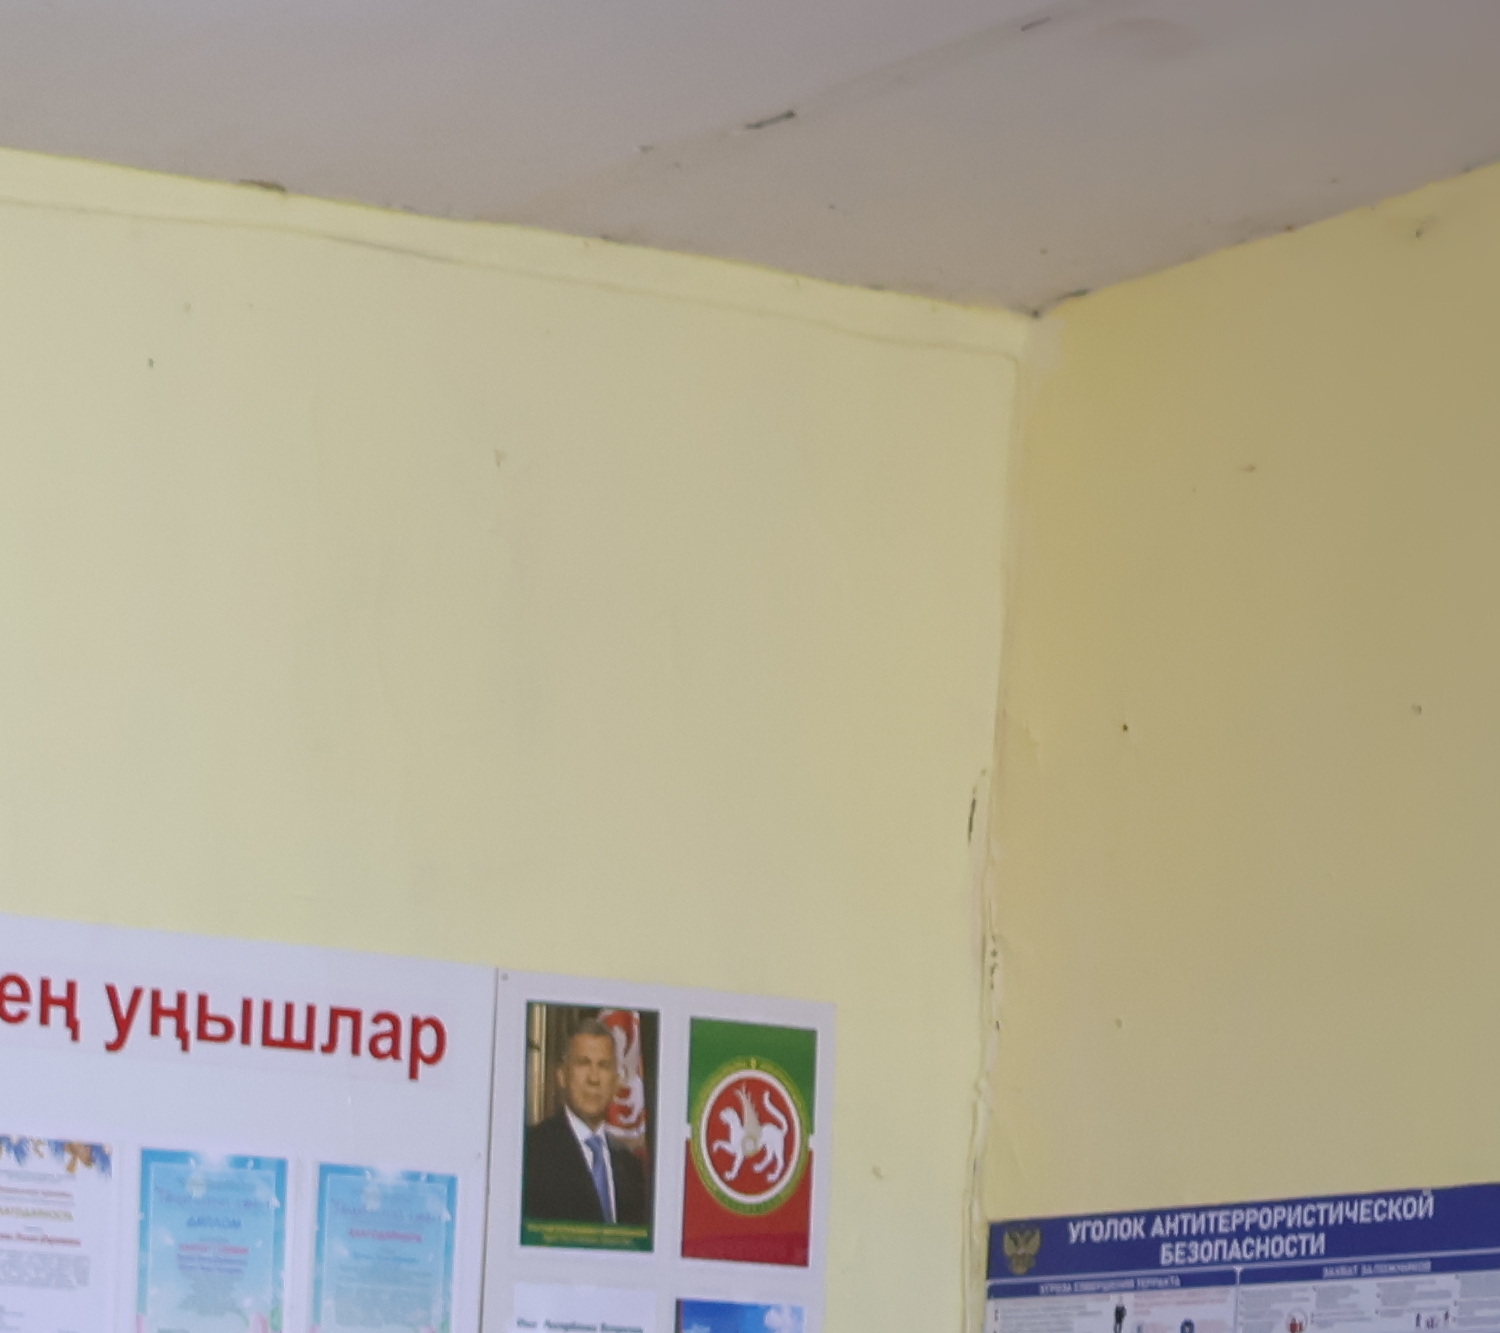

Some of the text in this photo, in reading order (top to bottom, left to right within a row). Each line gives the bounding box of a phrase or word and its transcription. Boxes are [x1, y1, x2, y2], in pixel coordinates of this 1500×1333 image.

[104, 982, 448, 1082] уңышлар
[1068, 1189, 1435, 1244] УГОЛОК АНТИТЕРРОРИСТИЧЕСКОЙ
[1160, 1232, 1326, 1266] БЕЗОПАСНОСТИ
